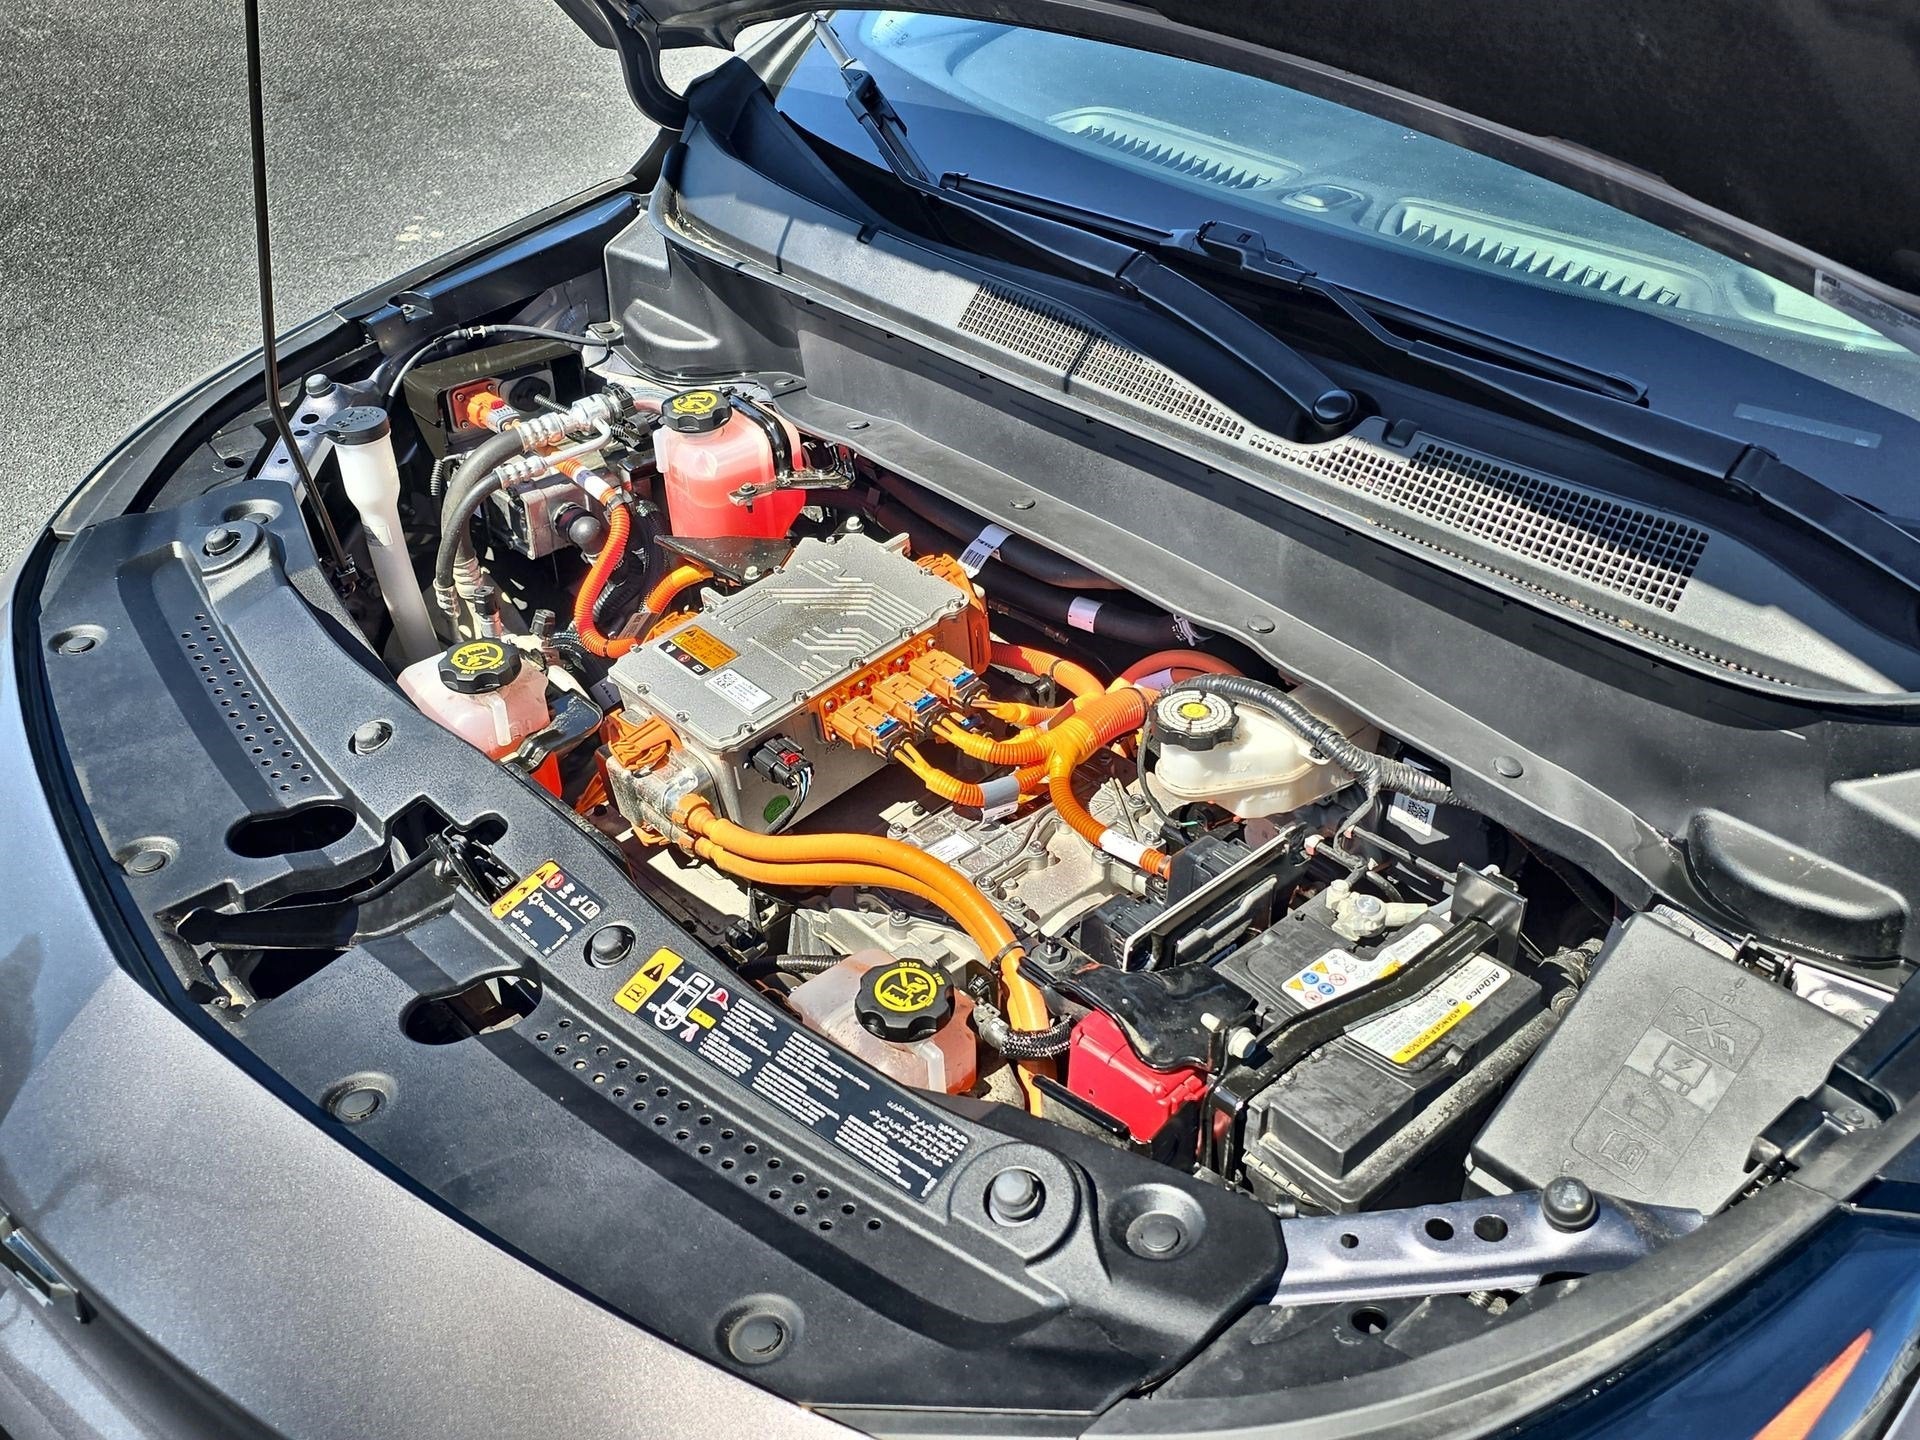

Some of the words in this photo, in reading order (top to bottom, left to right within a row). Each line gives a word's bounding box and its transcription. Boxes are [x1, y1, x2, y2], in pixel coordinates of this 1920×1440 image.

[1465, 970, 1501, 1001] ACDelco
[1431, 1012, 1458, 1036] DANGER
[1404, 1034, 1431, 1055] POISON
